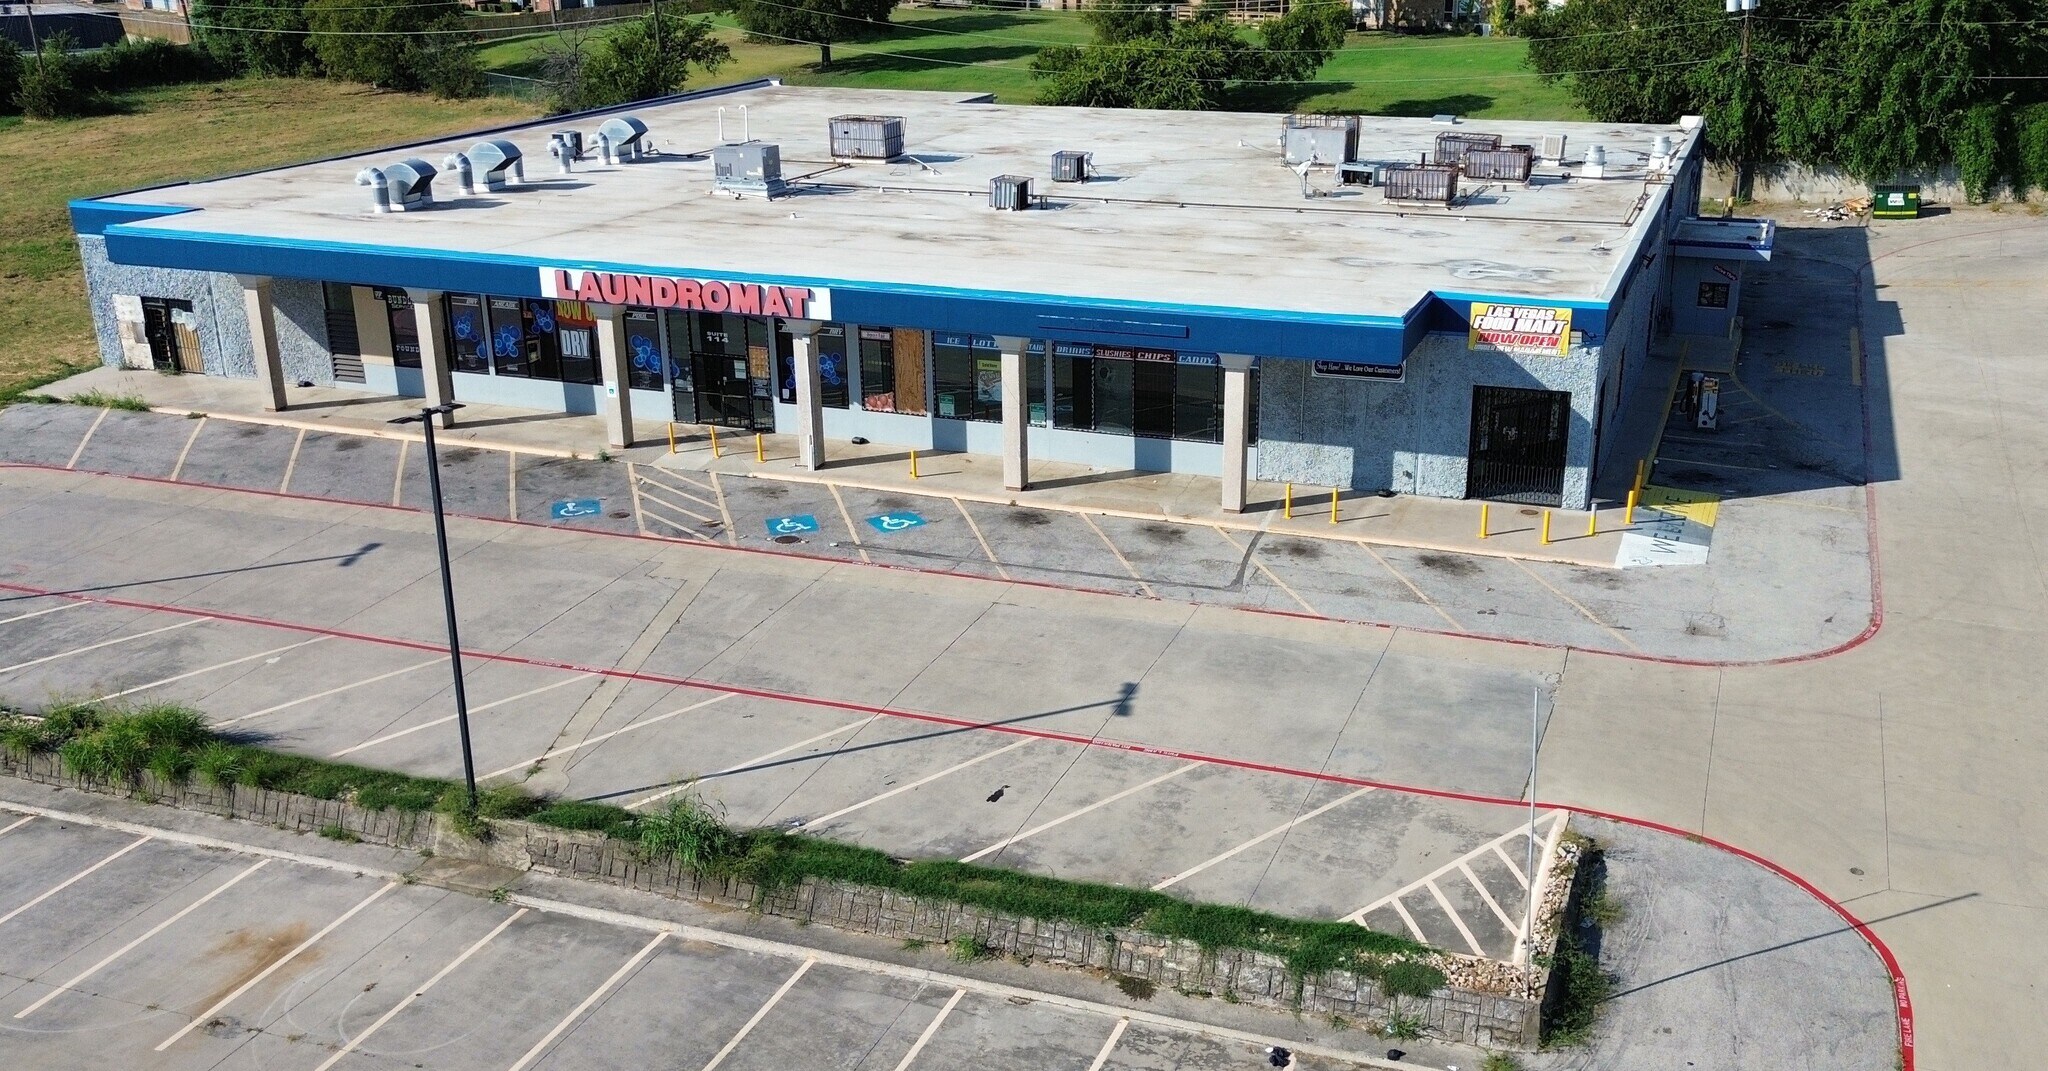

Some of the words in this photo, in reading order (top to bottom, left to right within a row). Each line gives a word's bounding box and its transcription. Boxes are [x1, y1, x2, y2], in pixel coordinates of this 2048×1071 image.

[555, 270, 816, 317] LAUNDROMAT
[1487, 305, 1513, 318] LAS
[1514, 307, 1556, 320] VEGAS
[1472, 315, 1515, 331] FOOD
[1514, 318, 1568, 334] MART
[561, 329, 588, 357] DRY
[947, 337, 960, 345] ICE
[973, 340, 998, 348] LOTT
[1478, 332, 1518, 344] NOW
[1520, 334, 1560, 347] OPEN
[1056, 346, 1091, 355] DRINKS
[1096, 349, 1132, 358] SLUSHIES
[1137, 351, 1171, 361] CHIPS
[1178, 355, 1215, 364] CANDY
[1901, 1017, 1911, 1033] LANE
